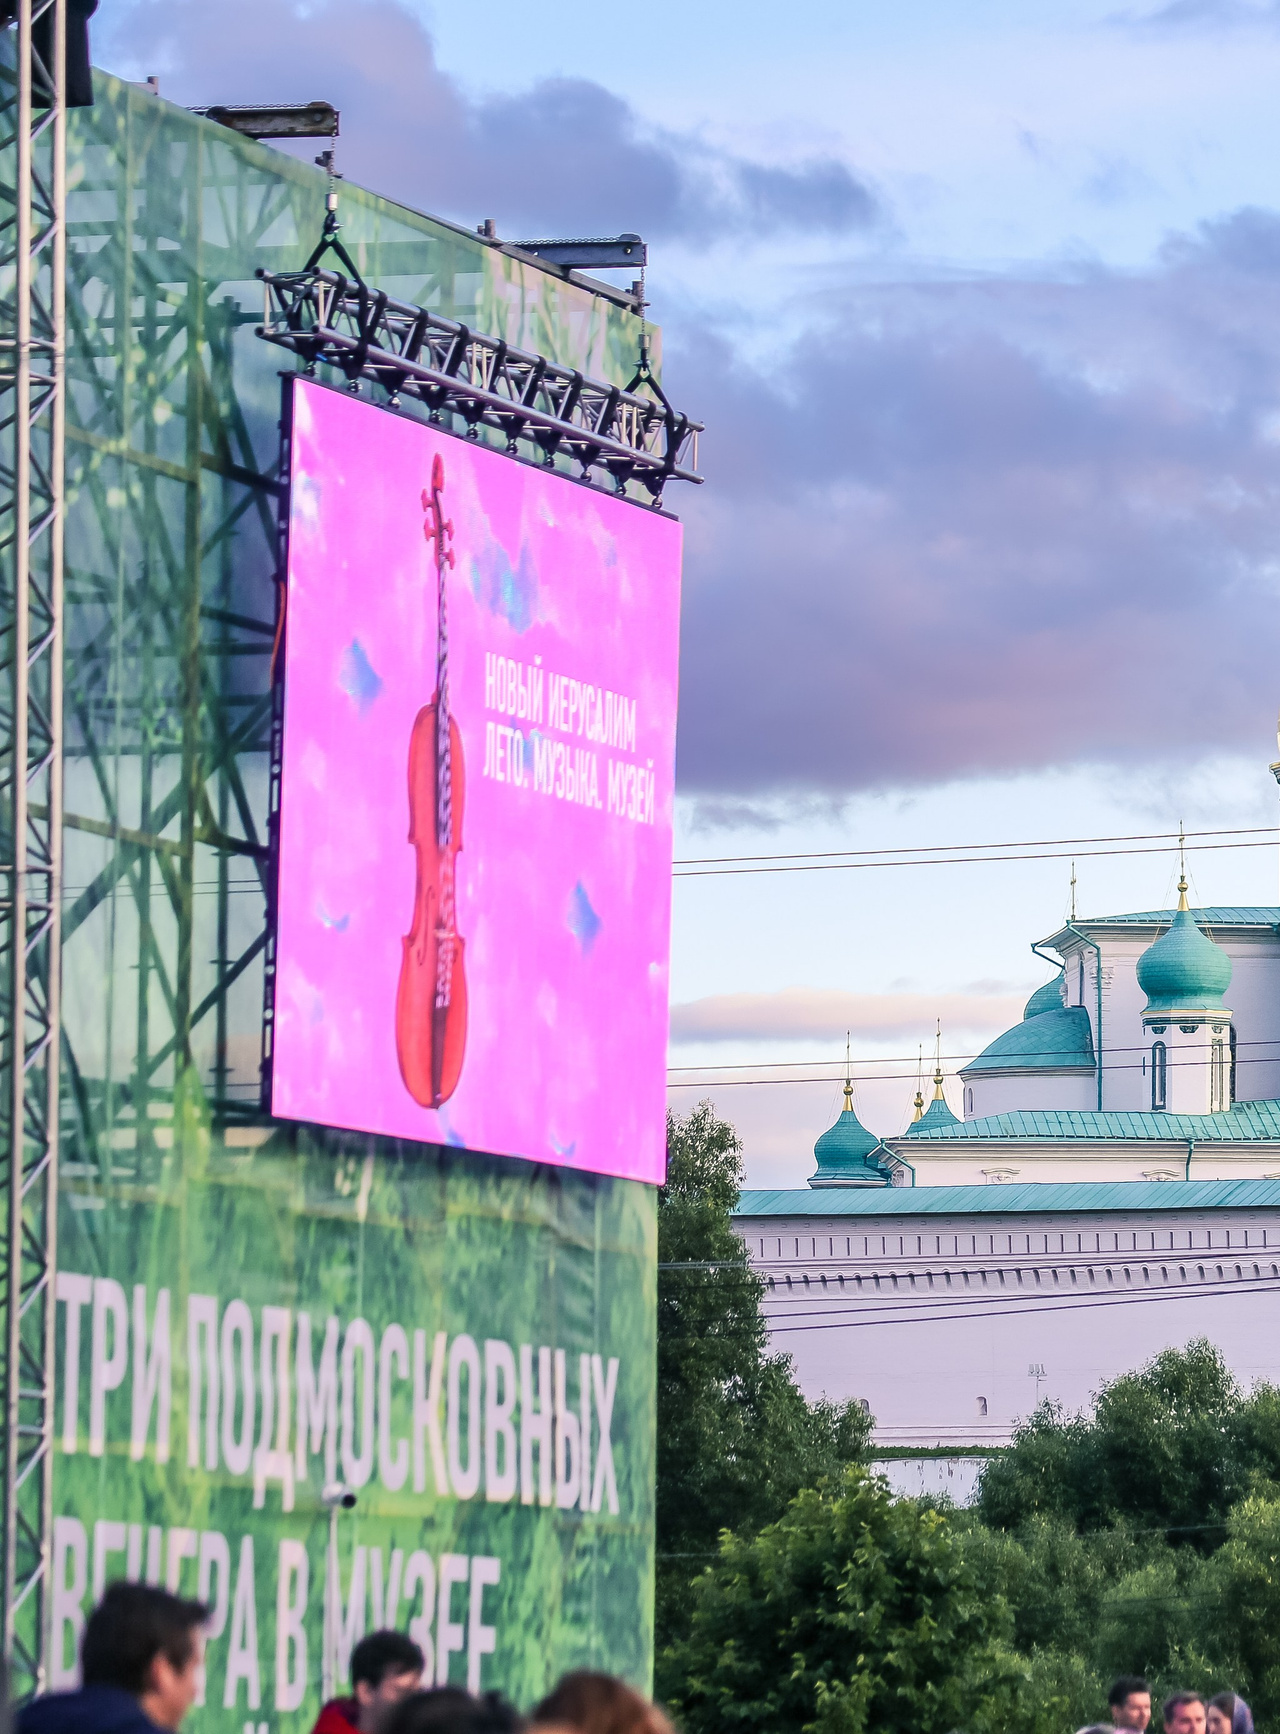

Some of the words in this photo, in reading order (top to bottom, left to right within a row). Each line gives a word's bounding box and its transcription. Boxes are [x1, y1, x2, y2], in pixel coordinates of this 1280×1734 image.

[485, 651, 544, 724] НОВЫЙ
[548, 671, 636, 753] ИЕРУСАЛИМ
[483, 721, 529, 788] ЛЕТО.
[533, 734, 603, 810] МУЗЫКА.
[607, 758, 655, 825] МУЗЕЙ
[55, 1271, 171, 1464] ТРИ
[187, 1293, 620, 1515] ПОДМОСКОВНЫХ
[274, 1538, 309, 1711] В
